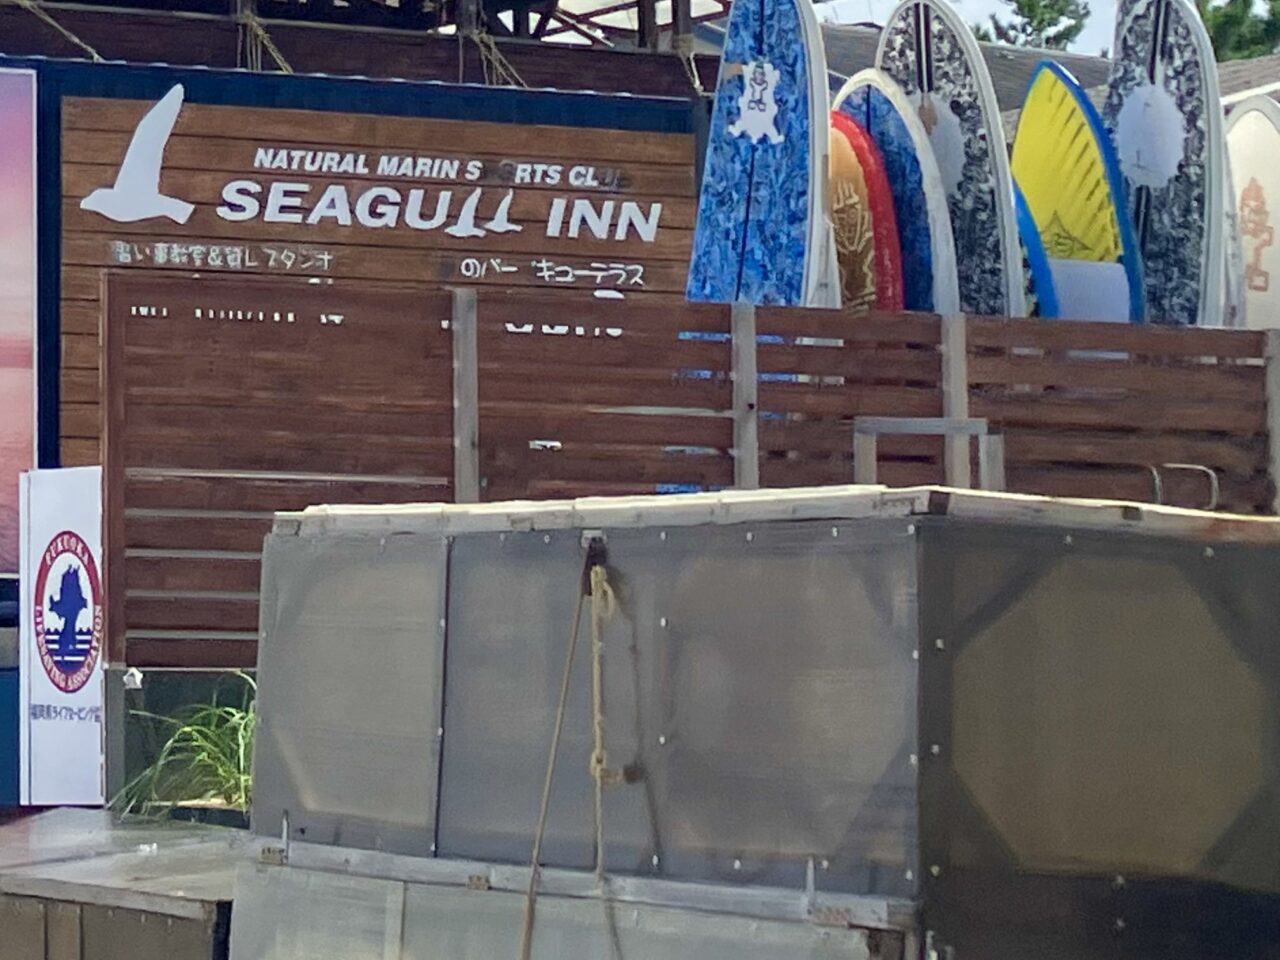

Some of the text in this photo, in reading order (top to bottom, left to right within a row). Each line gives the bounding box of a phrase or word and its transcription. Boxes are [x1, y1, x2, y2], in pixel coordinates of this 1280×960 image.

[254, 148, 631, 187] NATURAL MARIN SRTS CL
[546, 198, 662, 242] INN
